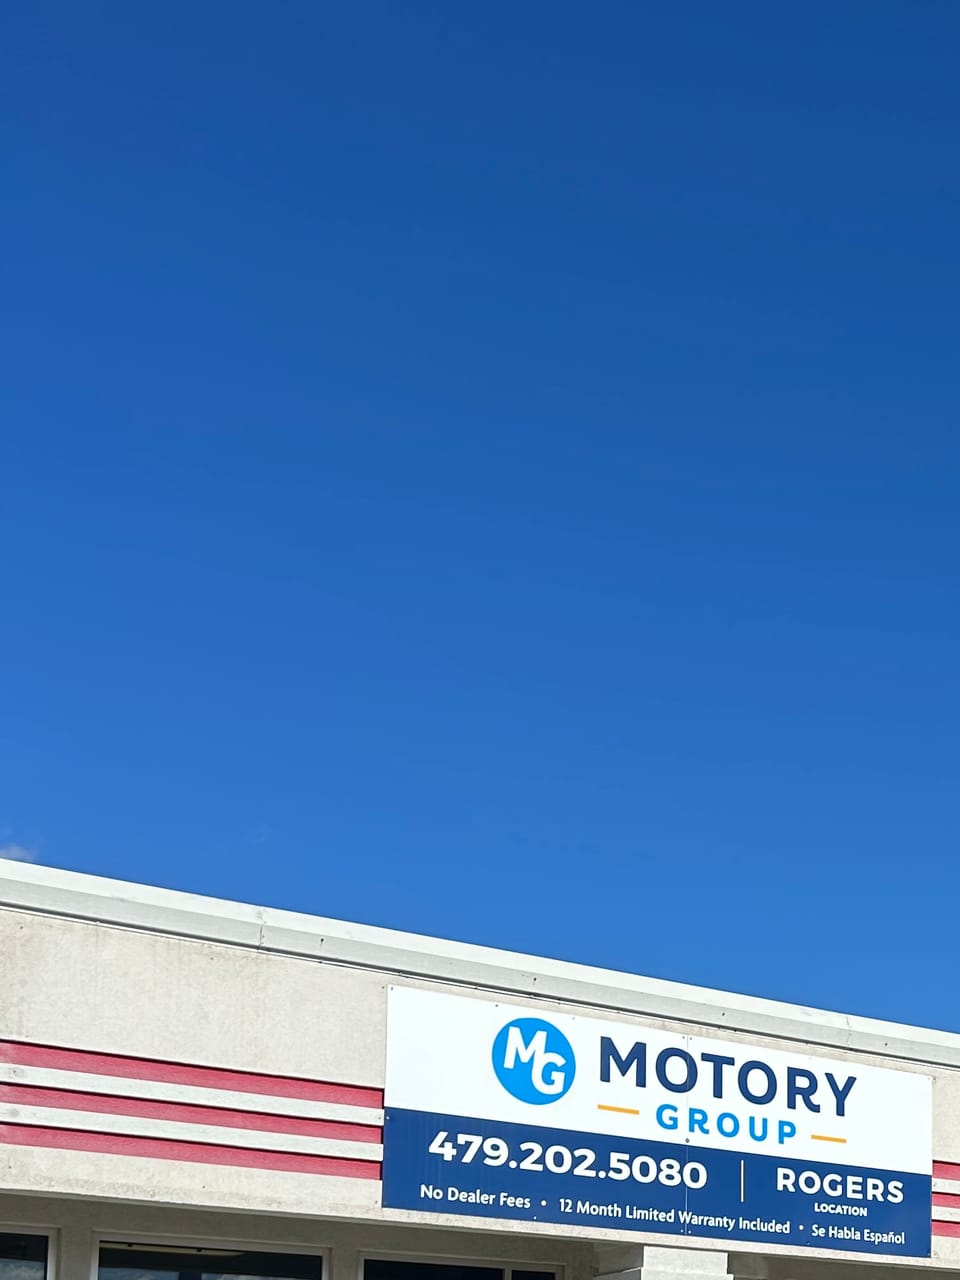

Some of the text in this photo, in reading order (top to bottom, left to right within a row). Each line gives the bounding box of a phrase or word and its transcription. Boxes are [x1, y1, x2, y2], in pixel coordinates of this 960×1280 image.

[503, 1026, 567, 1095] MG
[600, 1036, 857, 1117] MOTORY
[655, 1104, 797, 1144] GROUP
[428, 1131, 708, 1189] 479.202.5080
[776, 1167, 904, 1203] ROGERS
[420, 1184, 905, 1245] No Dealer Fees 12 Month Limited Warranty Included Se Habla Español
[814, 1202, 868, 1217] LOCATION
